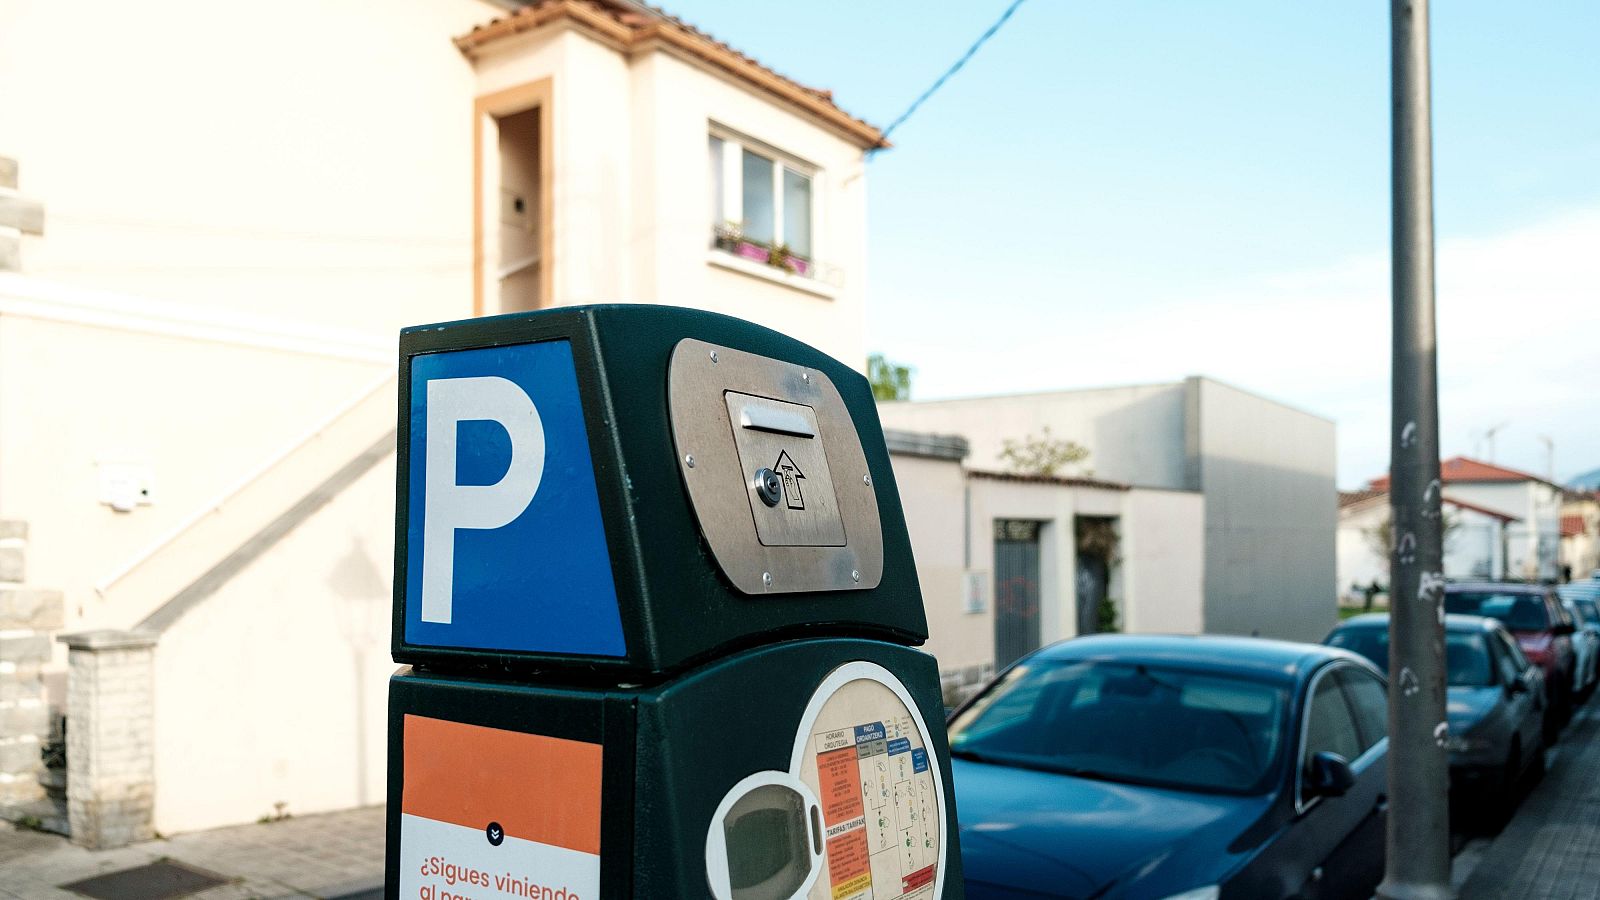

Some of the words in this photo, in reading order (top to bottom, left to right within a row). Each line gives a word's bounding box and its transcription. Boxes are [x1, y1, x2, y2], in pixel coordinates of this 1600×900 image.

[421, 376, 546, 624] P
[825, 731, 845, 740] HORARIO
[420, 856, 490, 888] ¿Sigues
[420, 884, 436, 900] al
